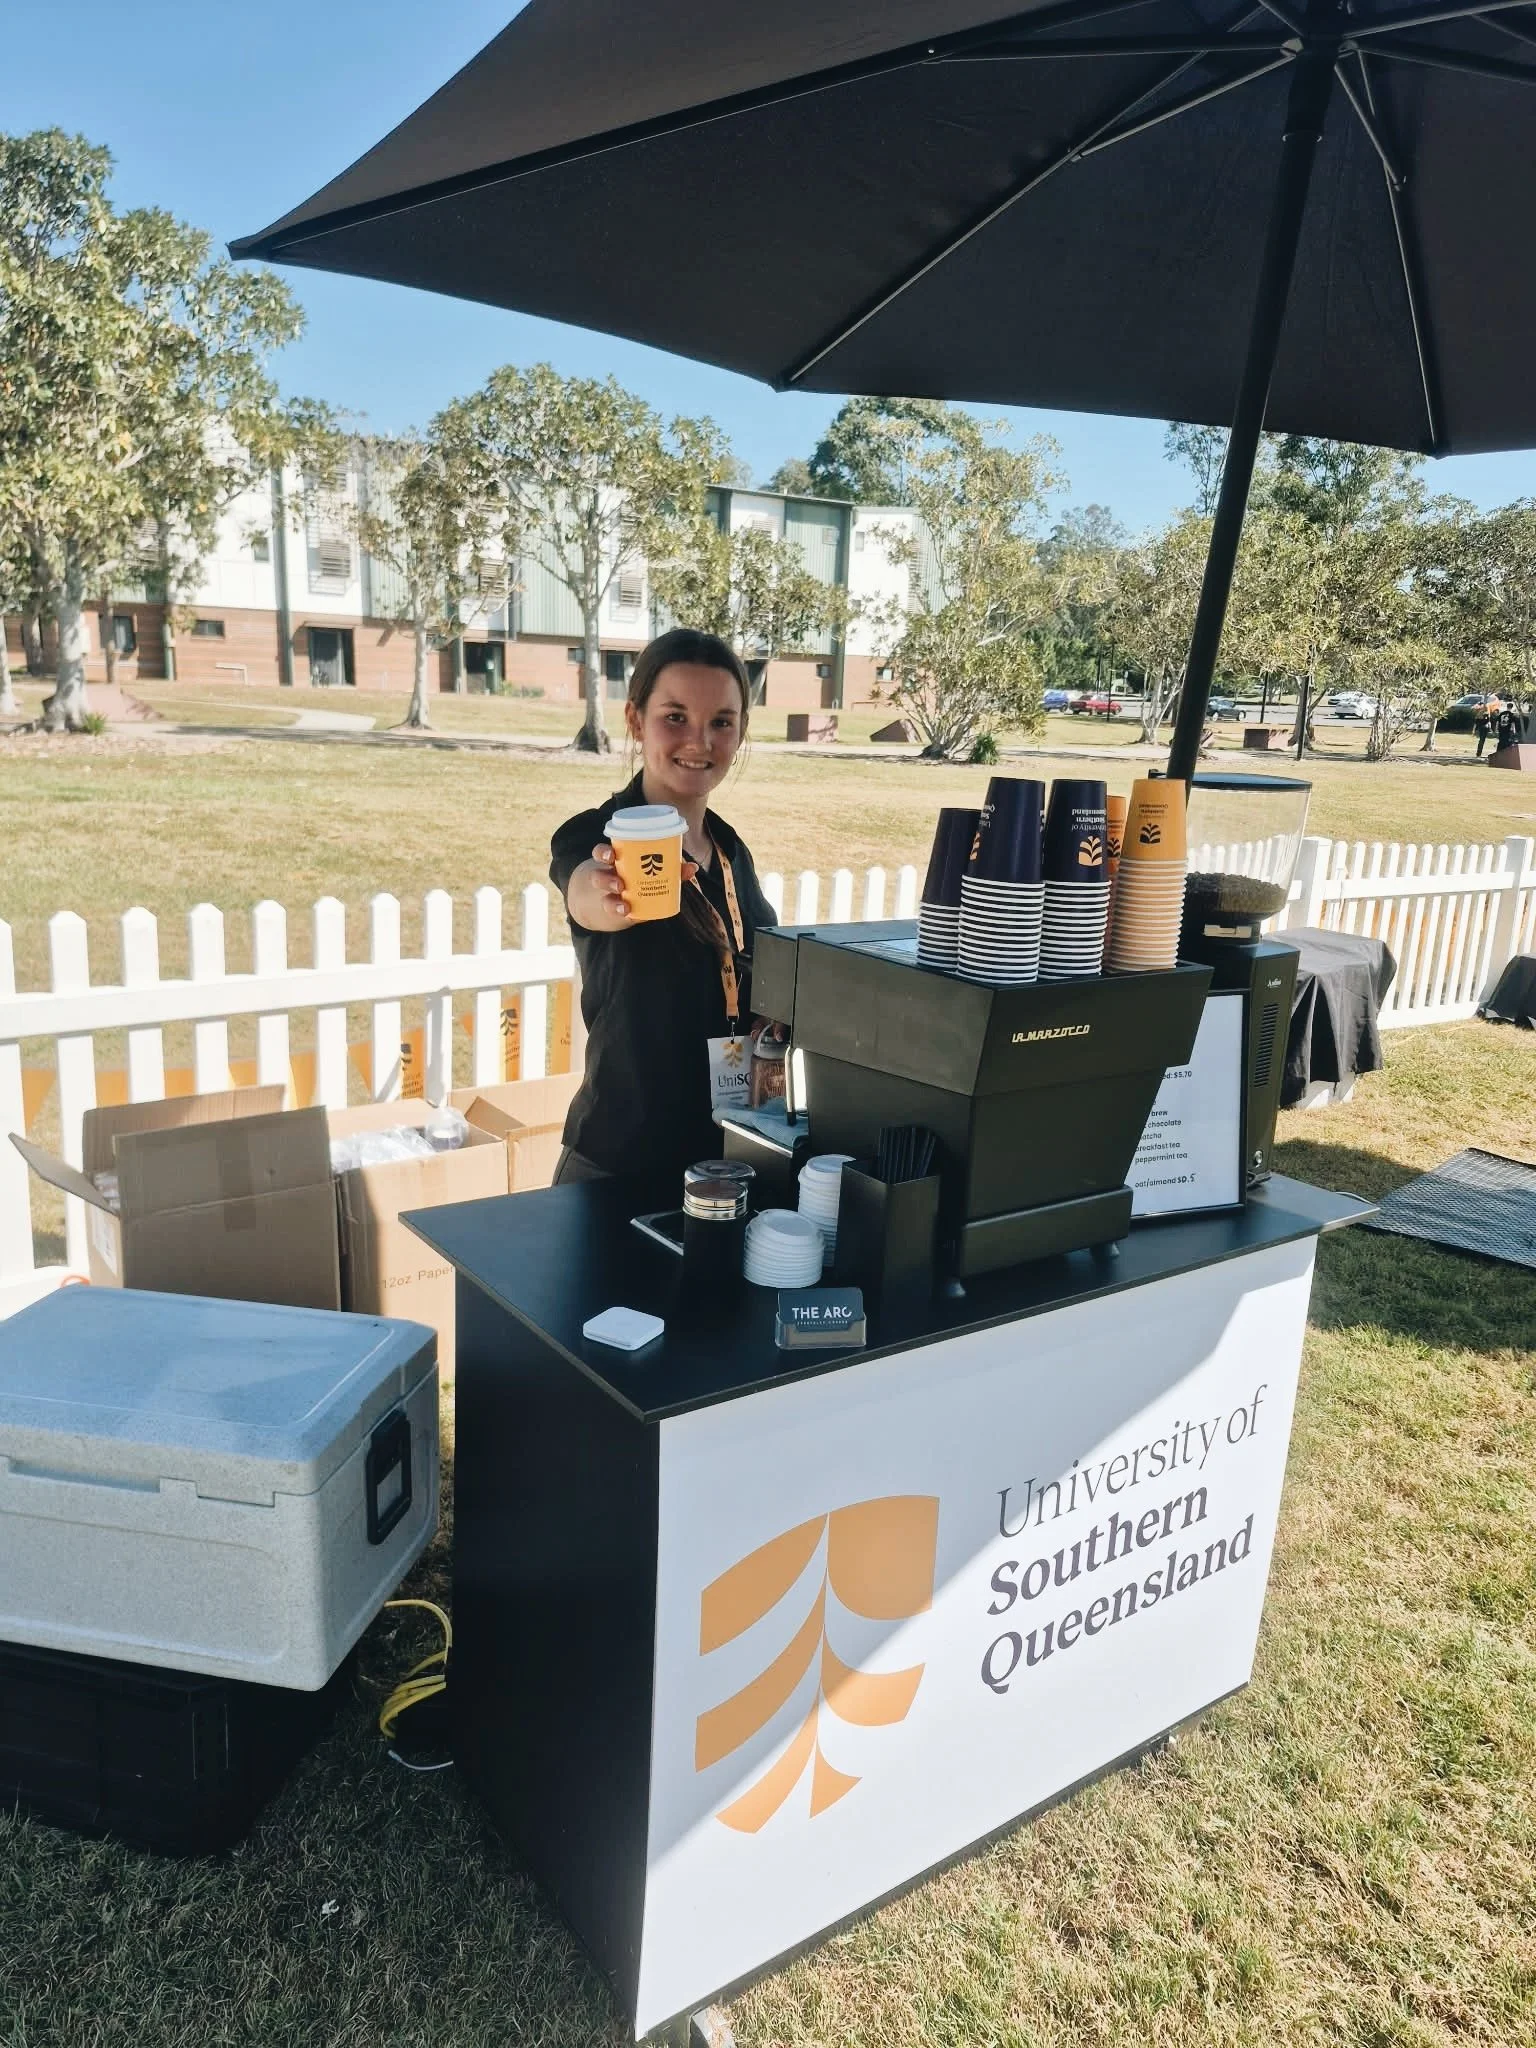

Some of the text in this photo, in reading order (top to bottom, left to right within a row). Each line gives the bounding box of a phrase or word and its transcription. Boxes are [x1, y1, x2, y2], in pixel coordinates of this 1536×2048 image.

[1011, 1024, 1091, 1043] LA MARZOCCO
[1148, 1120, 1182, 1129] chocolate
[1169, 1141, 1181, 1149] tea
[1135, 1152, 1189, 1164] peppermint tea
[382, 1275, 412, 1290] 12oz
[791, 1305, 853, 1320] THE ARC
[996, 1383, 1269, 1539] University of
[986, 1485, 1209, 1617] Southern
[980, 1512, 1256, 1695] Queensland
